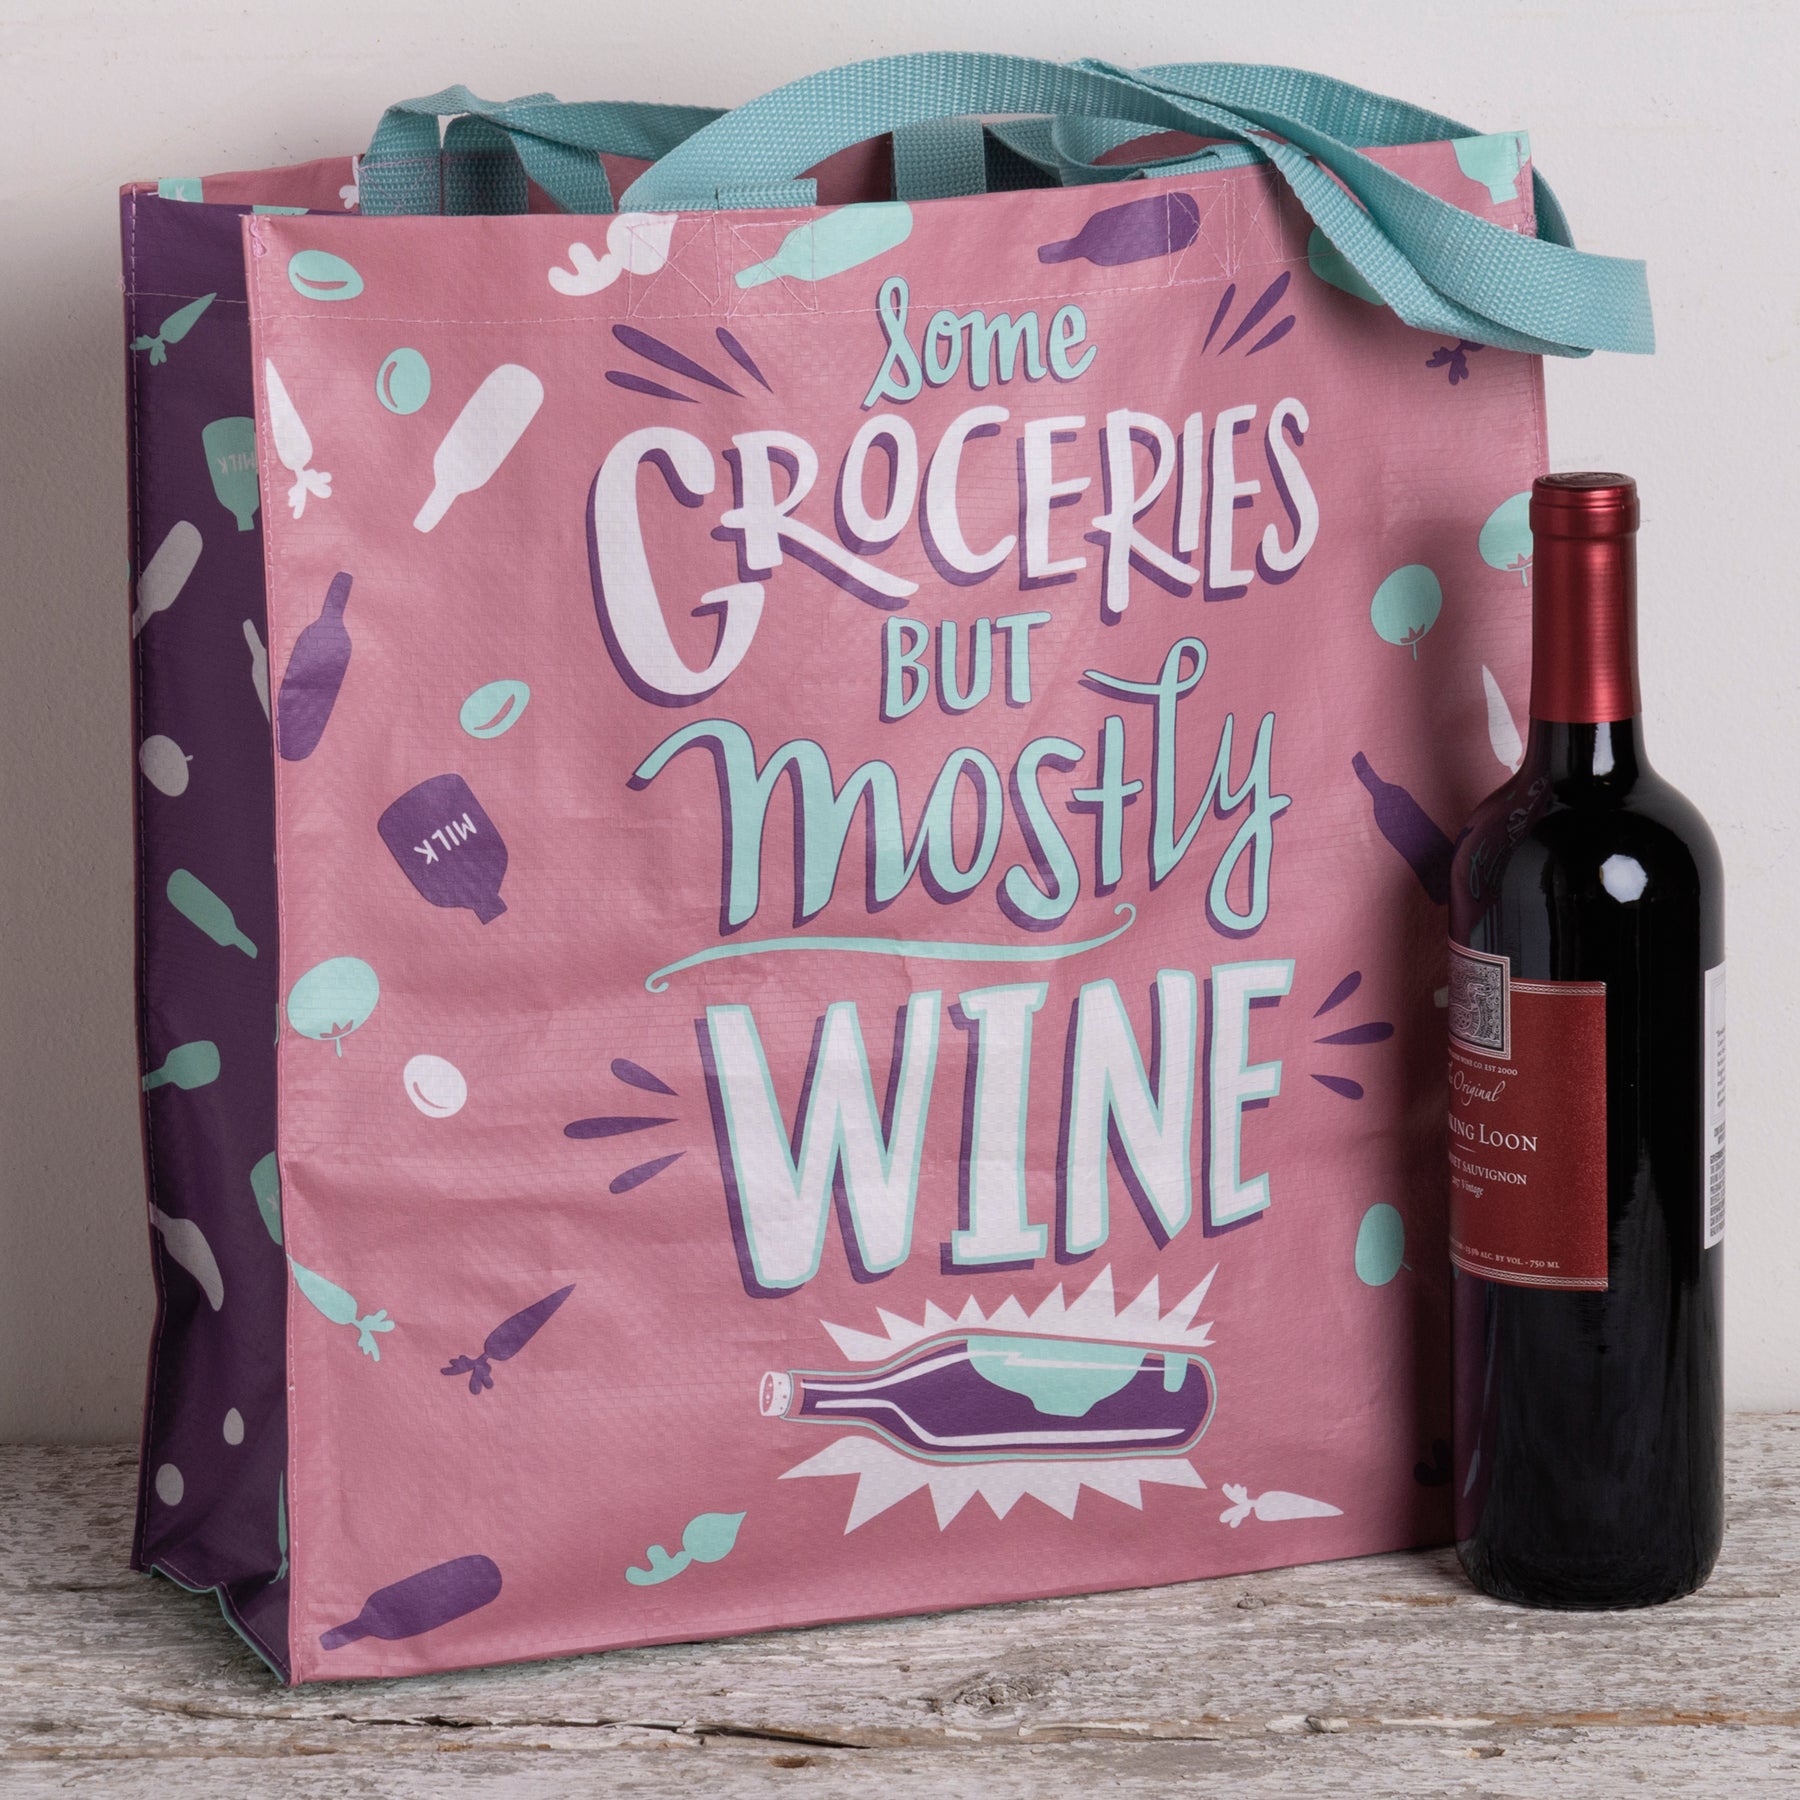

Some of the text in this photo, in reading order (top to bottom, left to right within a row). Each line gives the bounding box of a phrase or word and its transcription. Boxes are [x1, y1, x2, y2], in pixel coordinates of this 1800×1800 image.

[586, 397, 1319, 708] GROCERIES
[880, 611, 1052, 723] BUT
[413, 812, 477, 865] MILK
[1453, 1070, 1506, 1107] Original
[1498, 1066, 1519, 1076] 2000
[695, 959, 1296, 1298] WINE
[1462, 1161, 1528, 1185] SAUVIGNON
[1529, 1259, 1545, 1269] 750
